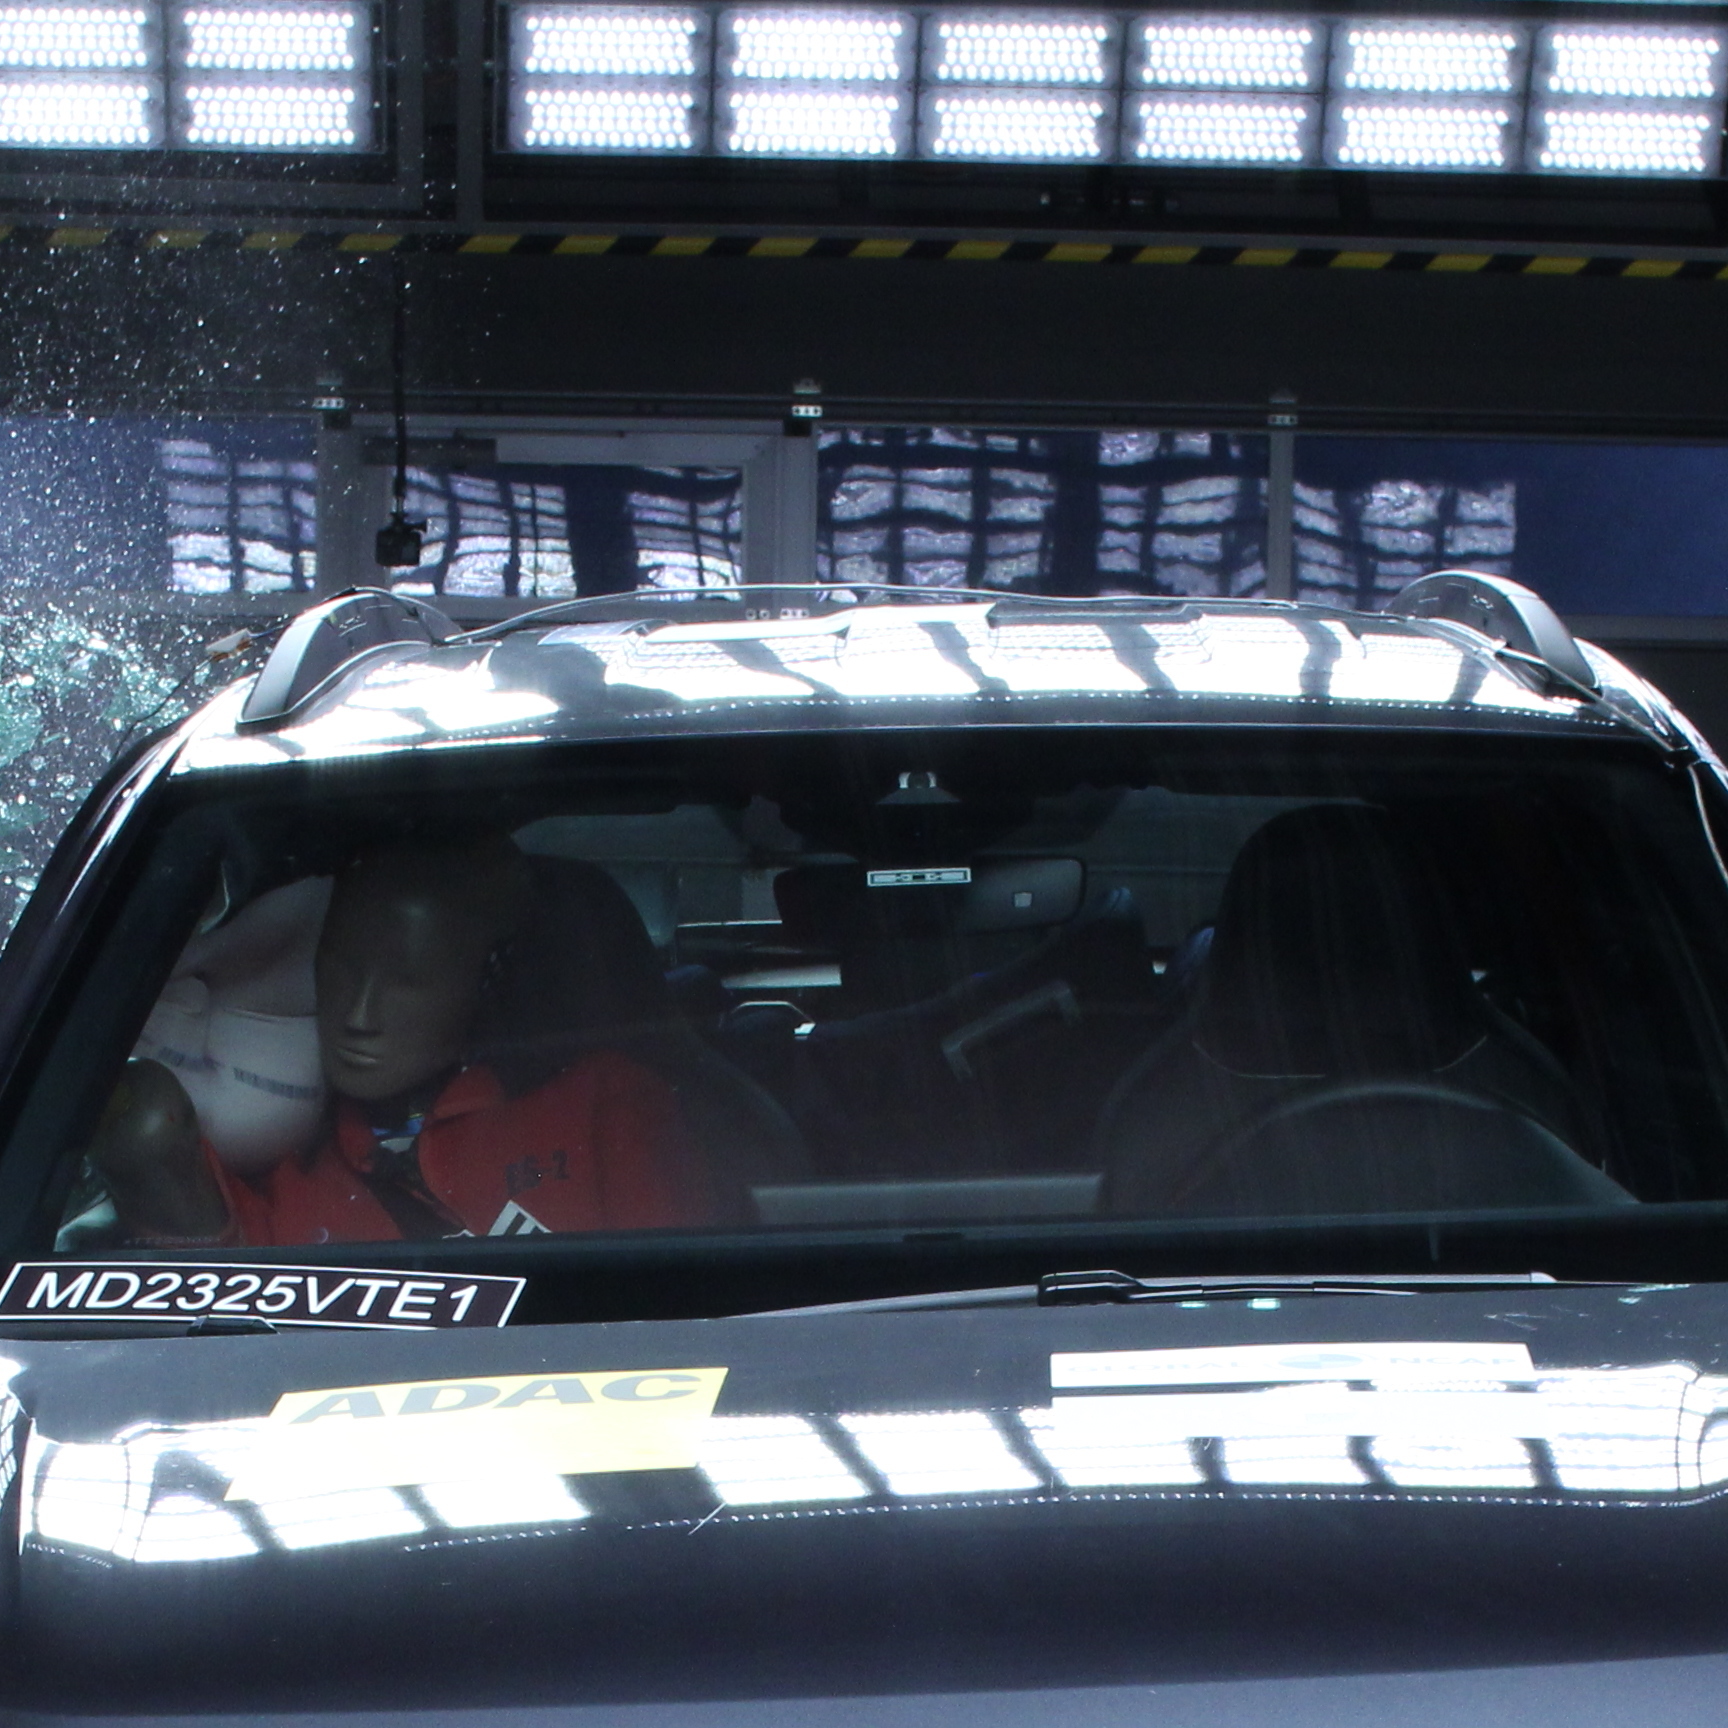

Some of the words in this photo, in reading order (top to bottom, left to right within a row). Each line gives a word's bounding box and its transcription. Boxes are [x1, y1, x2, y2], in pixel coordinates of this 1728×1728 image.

[25, 1271, 479, 1322] MD2325VTE1
[1066, 1360, 1248, 1373] GLOBAL
[1388, 1356, 1517, 1366] NCAP
[288, 1373, 703, 1425] ADAC
